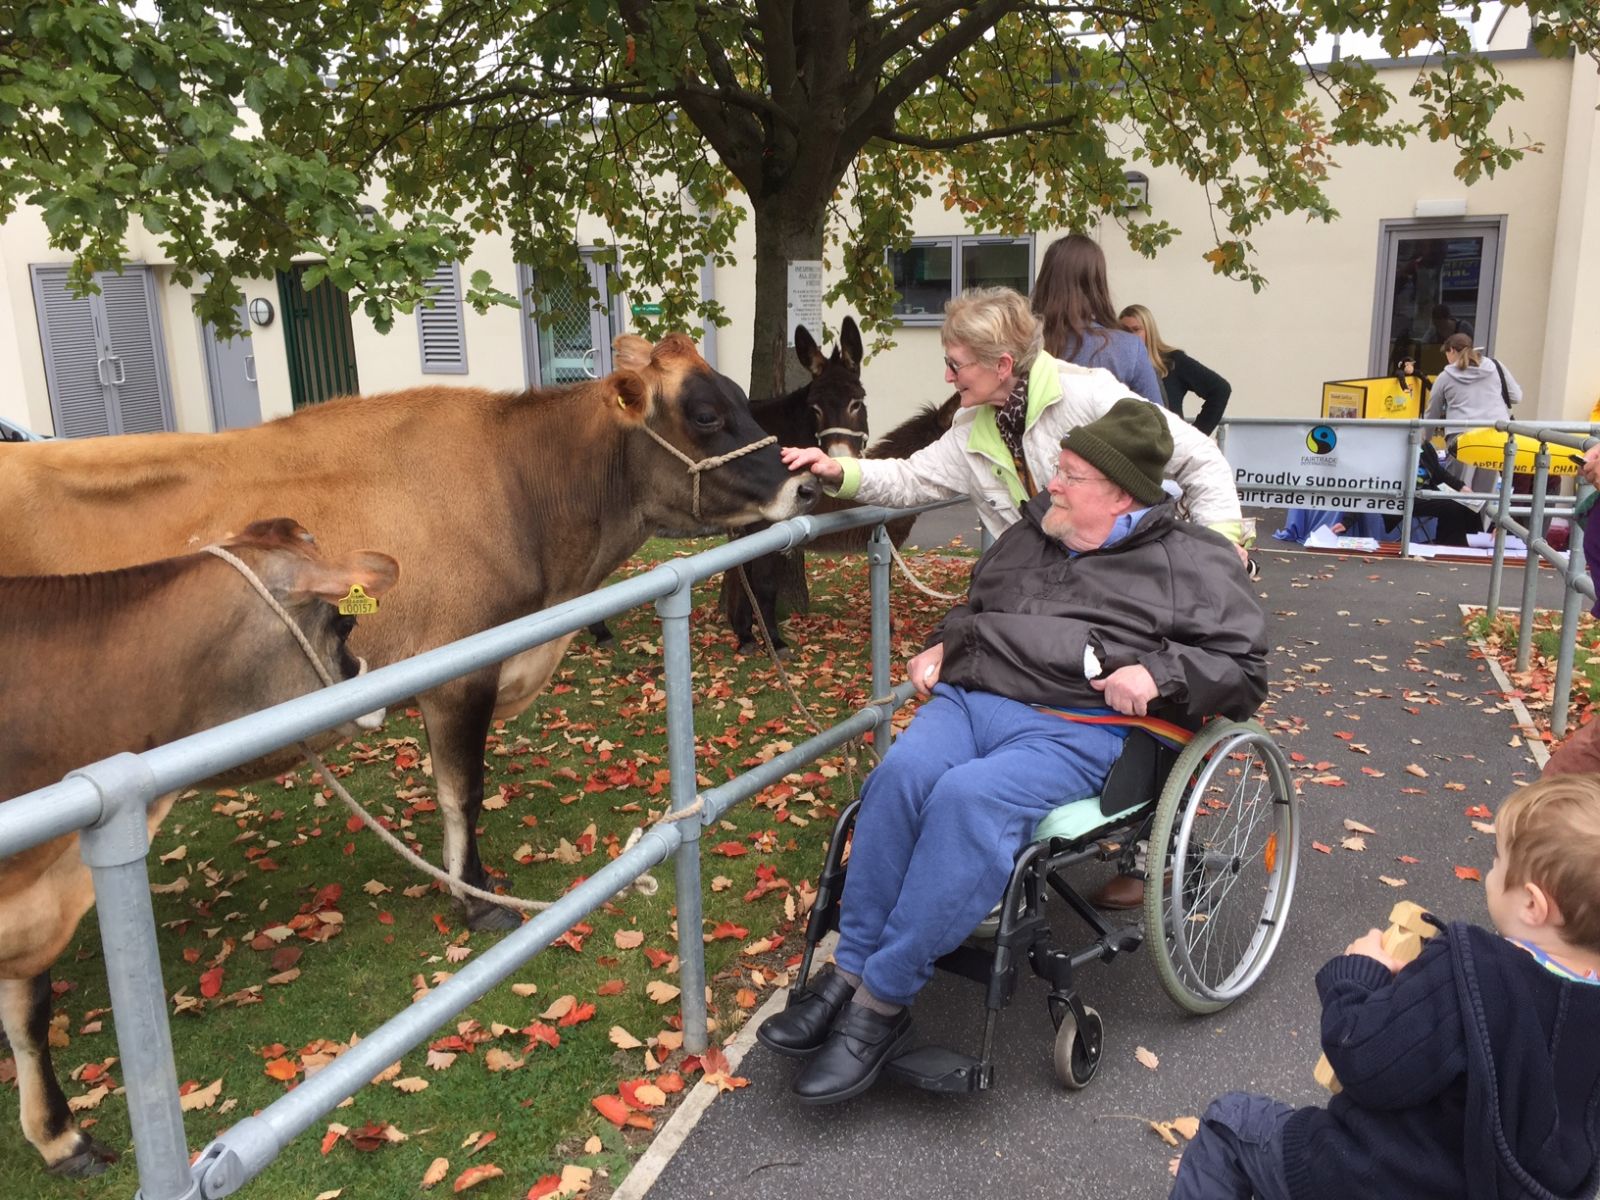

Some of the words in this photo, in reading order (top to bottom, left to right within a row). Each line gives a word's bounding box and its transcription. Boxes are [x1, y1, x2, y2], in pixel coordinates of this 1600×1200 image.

[1236, 469, 1300, 486] Proudly
[1306, 475, 1402, 490] supporting
[1237, 490, 1305, 505] airtrade
[1311, 493, 1325, 507] in
[1331, 496, 1357, 508] our
[1367, 498, 1406, 511] area
